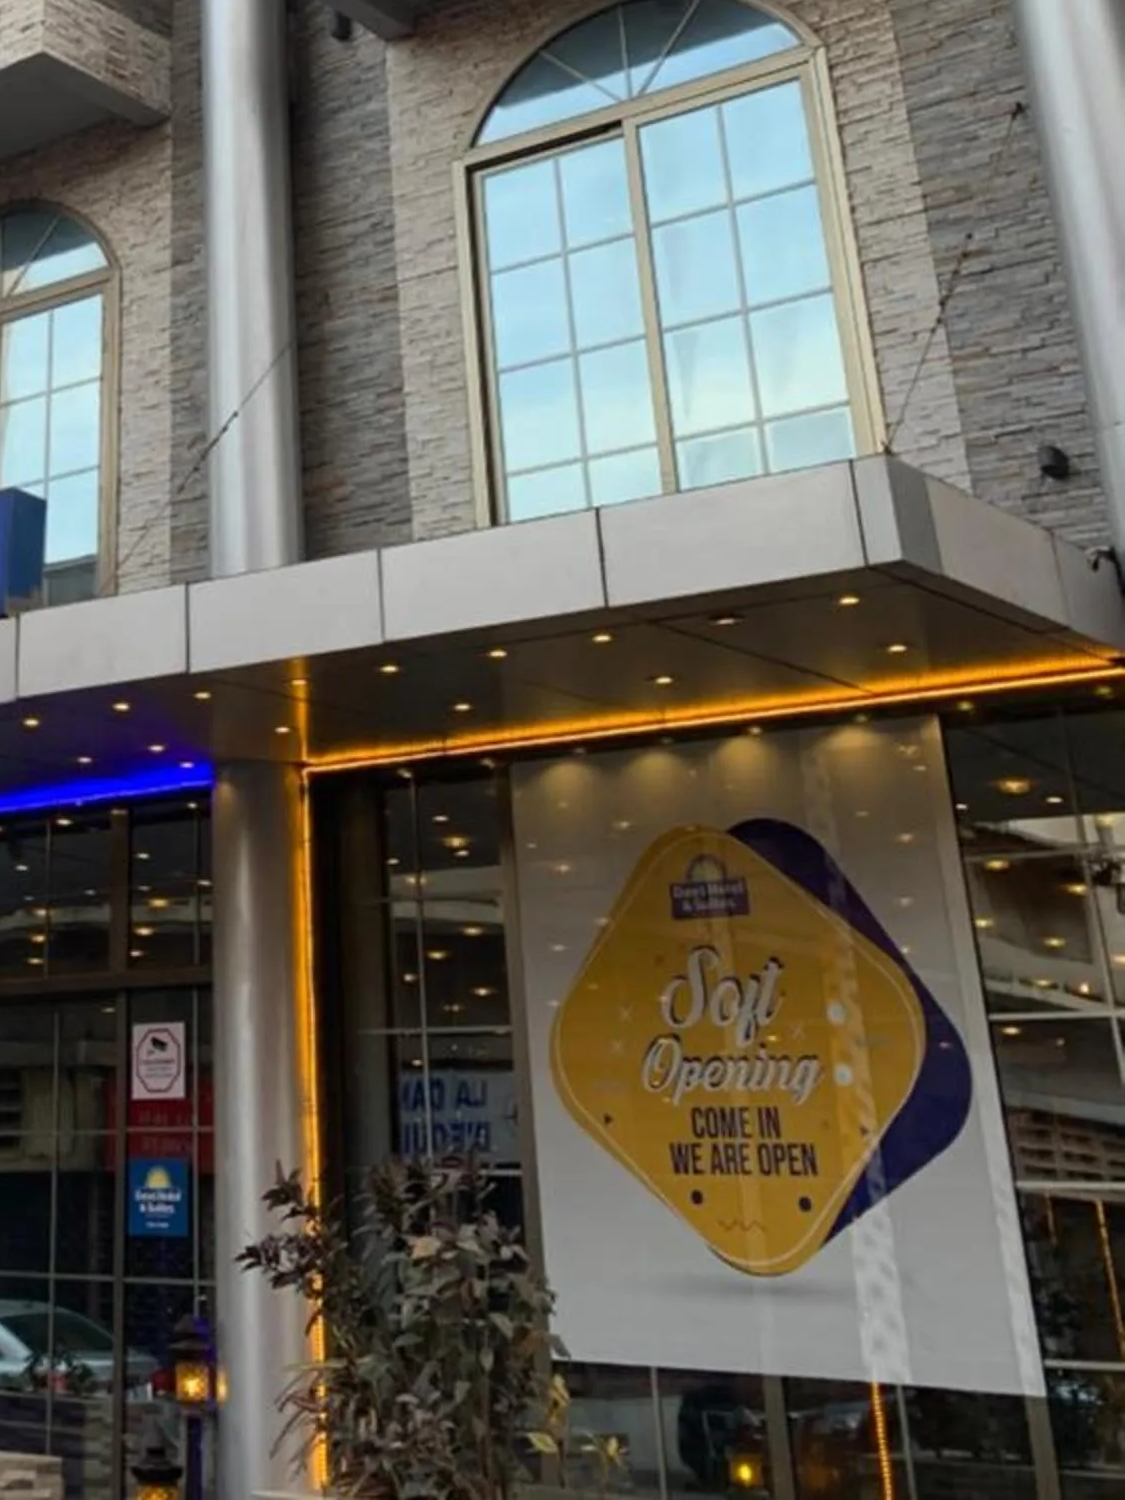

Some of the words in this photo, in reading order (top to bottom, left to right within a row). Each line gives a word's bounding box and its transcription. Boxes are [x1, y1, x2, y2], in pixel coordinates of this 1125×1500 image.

[661, 944, 784, 1047] Soft
[642, 1034, 823, 1106] Opening
[690, 1106, 752, 1140] COME
[757, 1106, 781, 1140] IN
[669, 1141, 705, 1176] WE
[711, 1142, 752, 1176] ARE
[757, 1142, 819, 1177] OPEN
